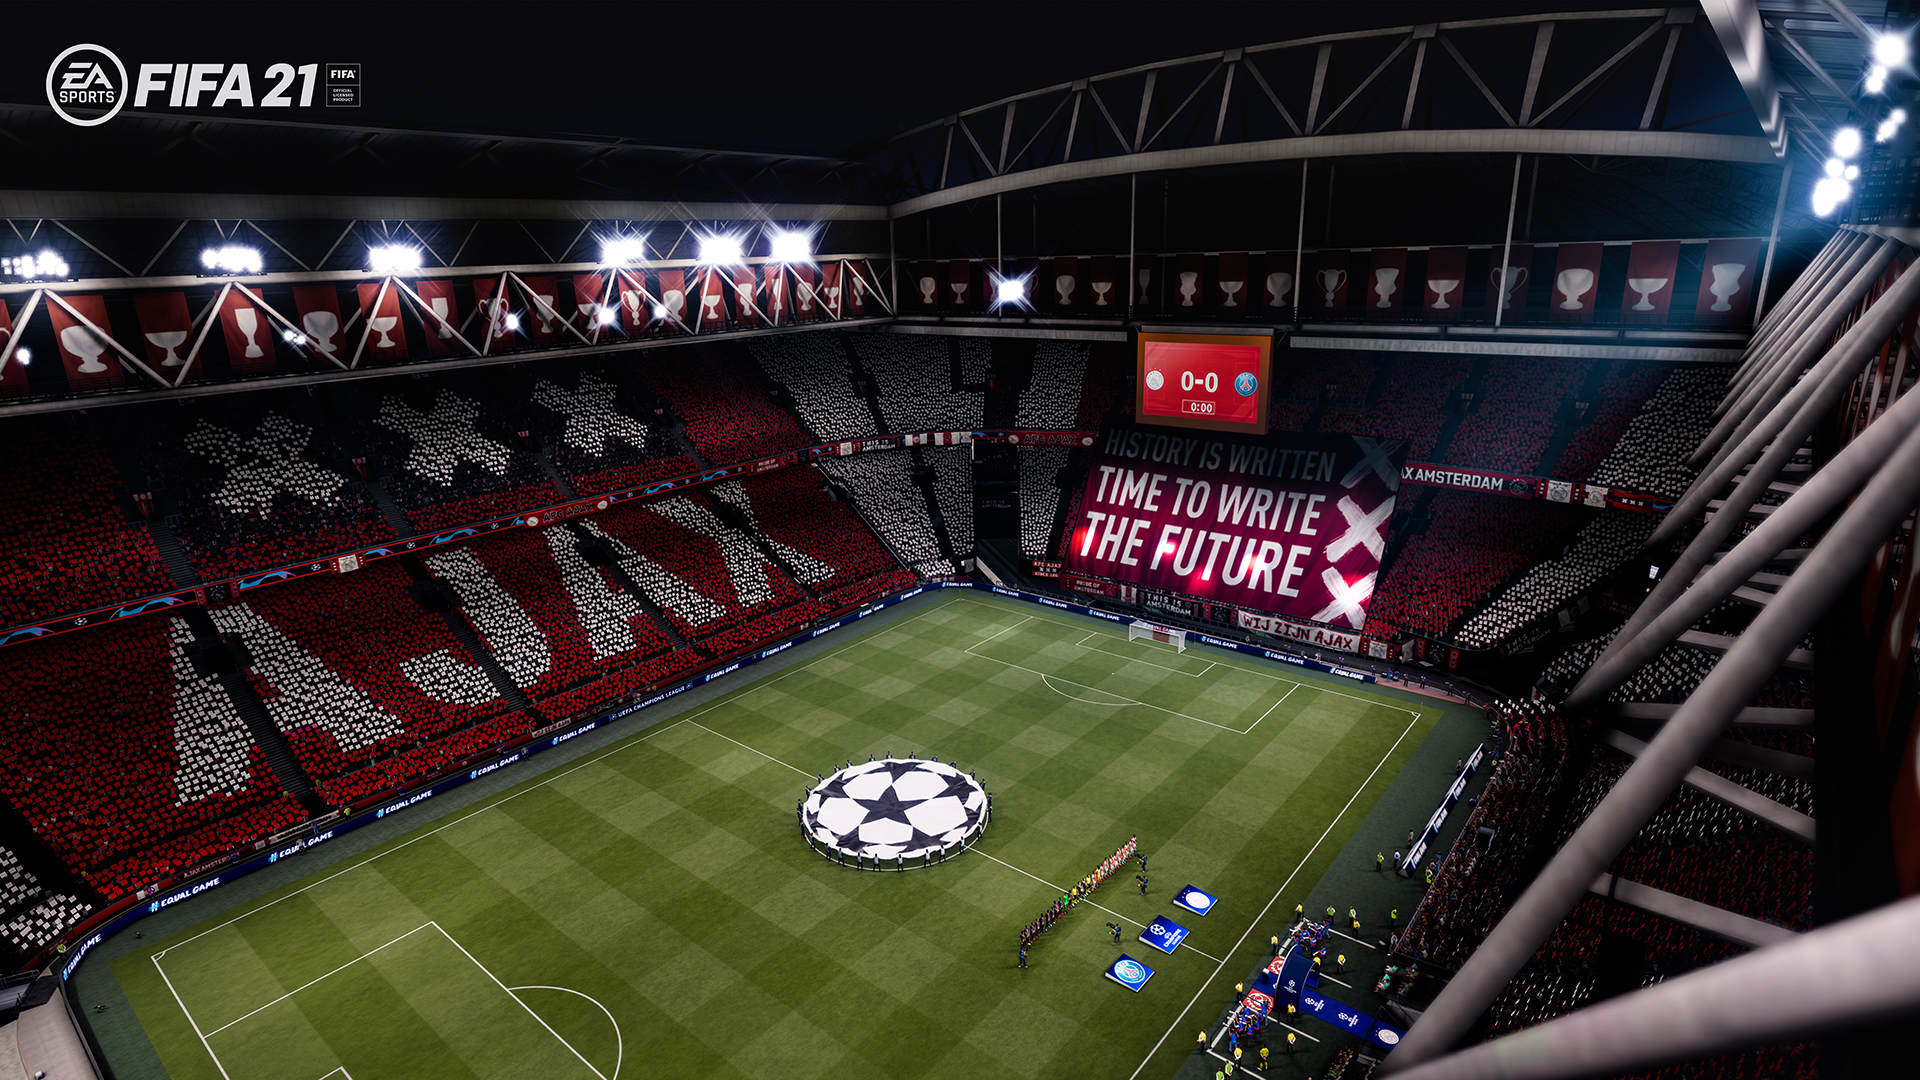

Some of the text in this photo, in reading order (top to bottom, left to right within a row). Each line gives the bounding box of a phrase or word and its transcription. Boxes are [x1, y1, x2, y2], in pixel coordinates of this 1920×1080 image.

[1181, 371, 1218, 393] 0-0
[1191, 402, 1212, 413] 0:00
[1023, 435, 1078, 445] AFC AJAX
[1104, 428, 1337, 482] HISTORY IS WRITTEN
[1414, 468, 1504, 491] AMSTERDAM
[1096, 465, 1326, 536] TIME TO WRITE
[542, 503, 594, 523] AFC AJAX
[1080, 510, 1312, 598] THE FUTURE
[1146, 601, 1191, 615] AMSTERDAM
[1147, 593, 1169, 603] THIS
[1243, 615, 1354, 650] WIJ ZIJN AJAX
[618, 707, 633, 718] UEFA
[633, 694, 665, 711] CHAMPIONS
[665, 685, 685, 698] LEAGUE
[500, 753, 520, 767] GAME
[410, 789, 433, 804] GAME
[308, 830, 334, 846] GAME
[192, 877, 220, 895] GAME
[81, 933, 102, 955] GAME
